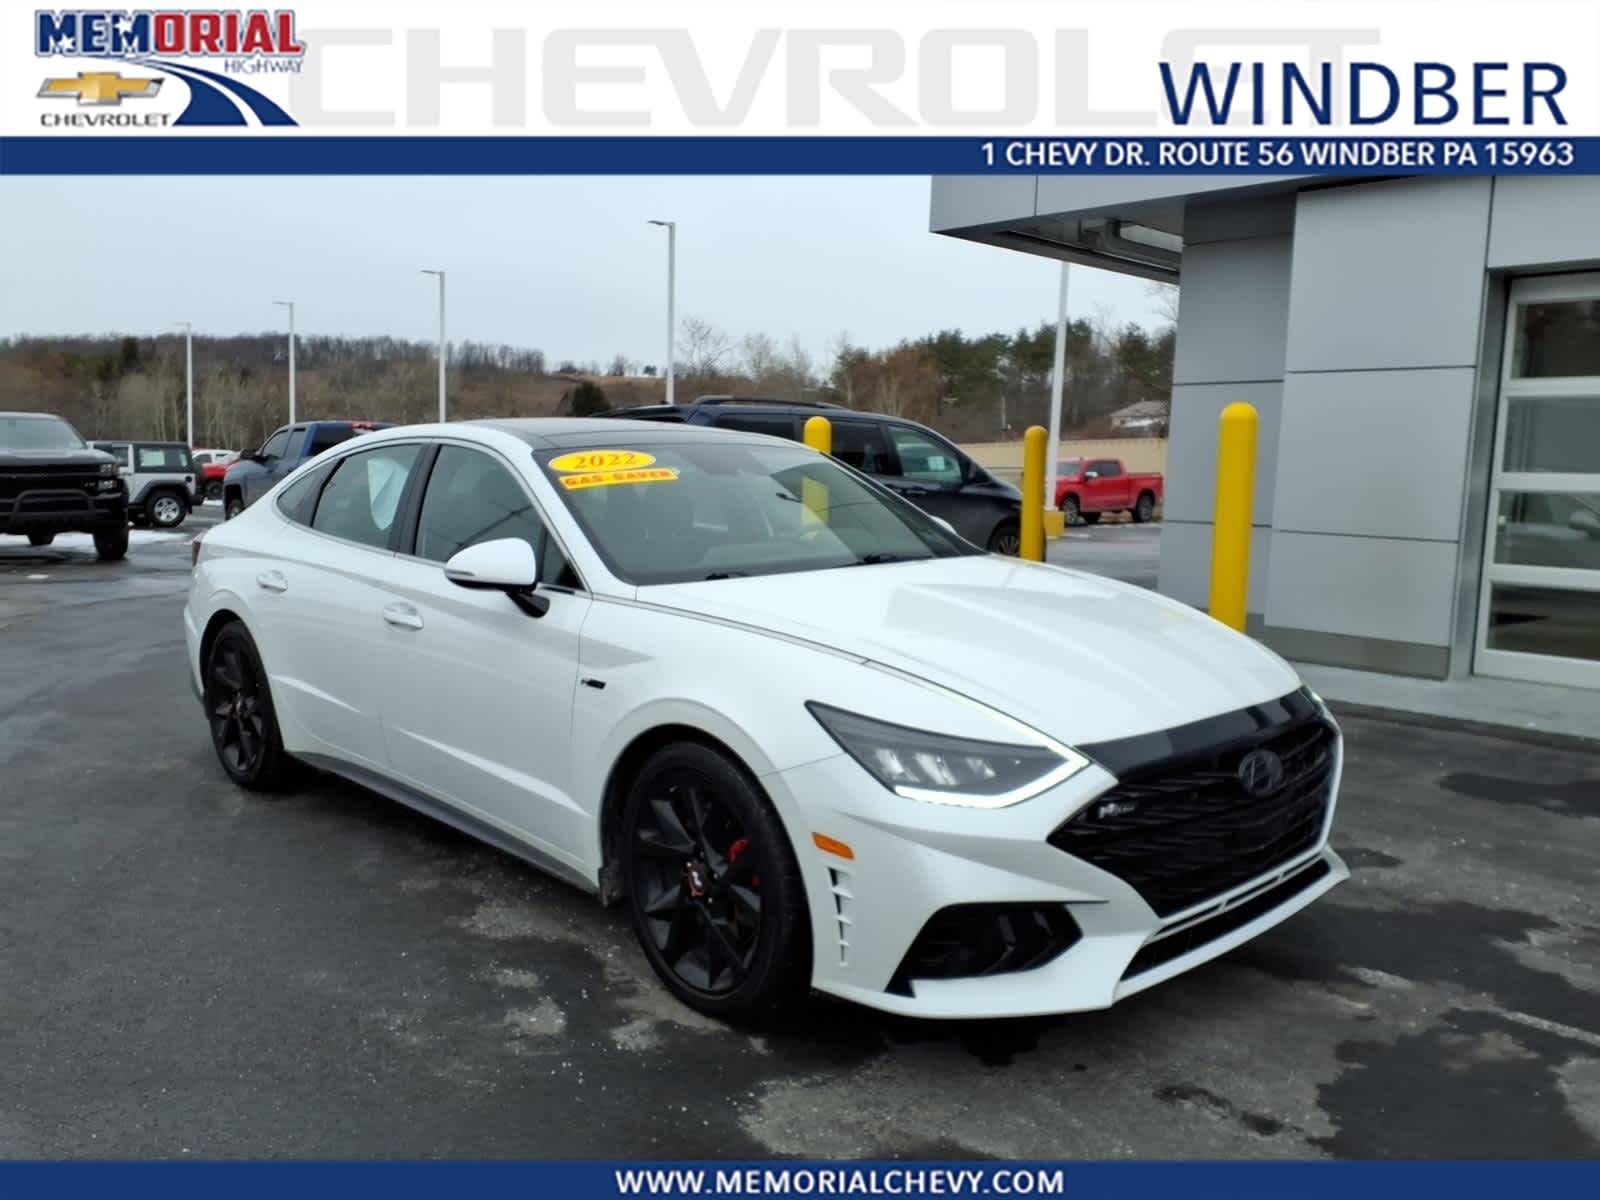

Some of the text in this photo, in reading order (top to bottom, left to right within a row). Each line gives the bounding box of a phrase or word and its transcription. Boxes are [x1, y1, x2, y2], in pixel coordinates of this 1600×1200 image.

[573, 453, 638, 470] 2022
[564, 469, 671, 486] GAS SAVER
